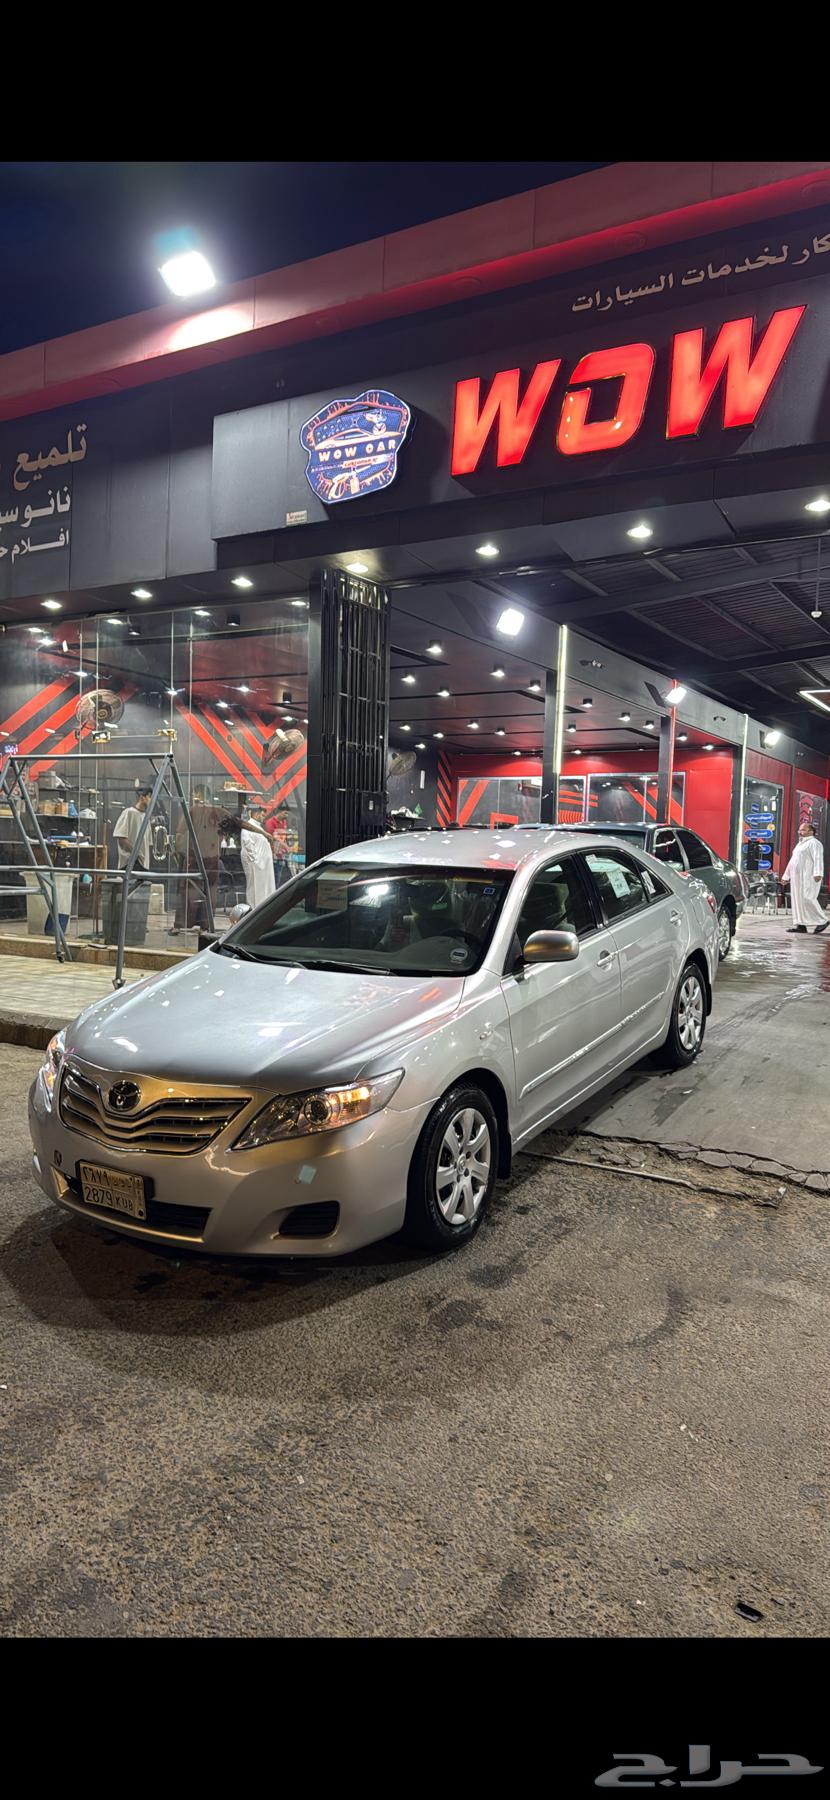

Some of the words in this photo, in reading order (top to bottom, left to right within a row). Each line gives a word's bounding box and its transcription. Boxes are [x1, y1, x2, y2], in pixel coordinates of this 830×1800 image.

[681, 244, 789, 287] لخدمات
[571, 271, 674, 313] السيارات
[450, 304, 808, 477] WOW
[13, 423, 87, 491] تلميع
[318, 445, 358, 463] WOW
[20, 485, 71, 528] نانو
[11, 527, 70, 565] افلام
[84, 1186, 114, 1207] 2879
